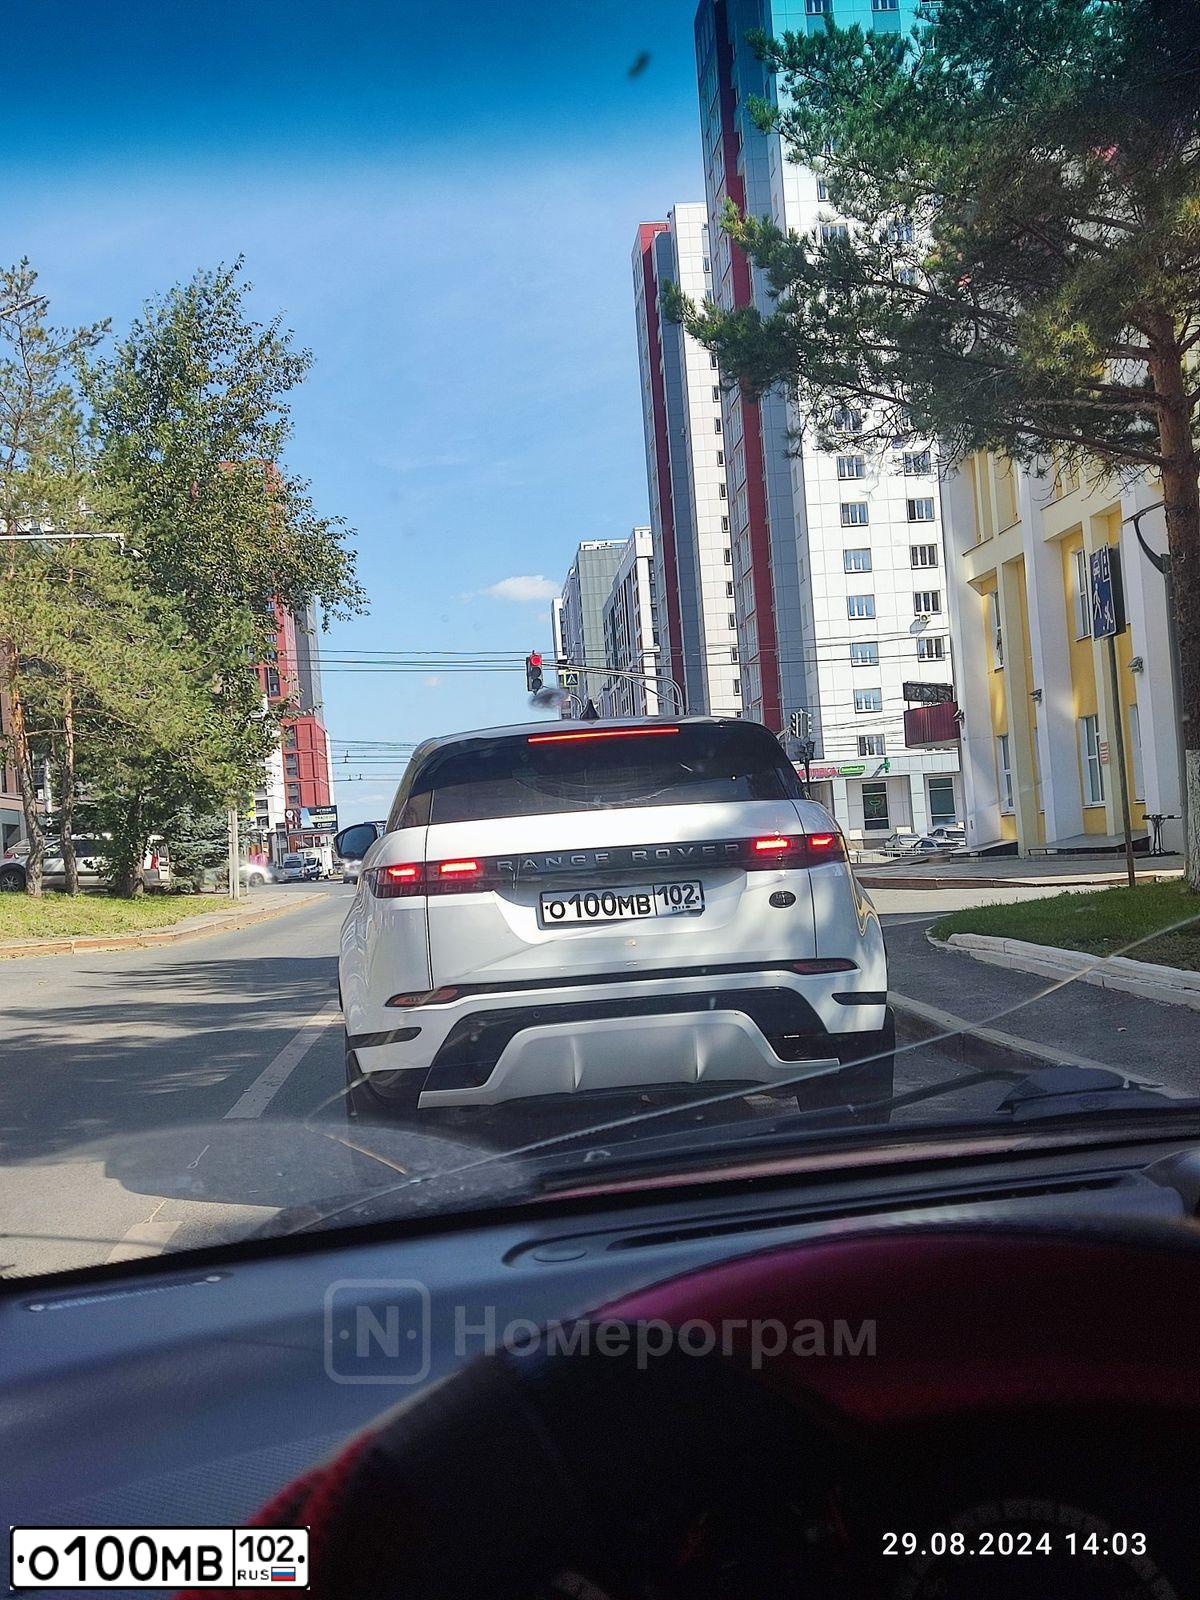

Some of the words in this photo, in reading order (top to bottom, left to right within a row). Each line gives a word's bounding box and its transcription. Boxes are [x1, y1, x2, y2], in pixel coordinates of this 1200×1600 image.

[497, 852, 609, 871] RANGE
[632, 844, 741, 862] ROVER
[658, 883, 697, 906] 102
